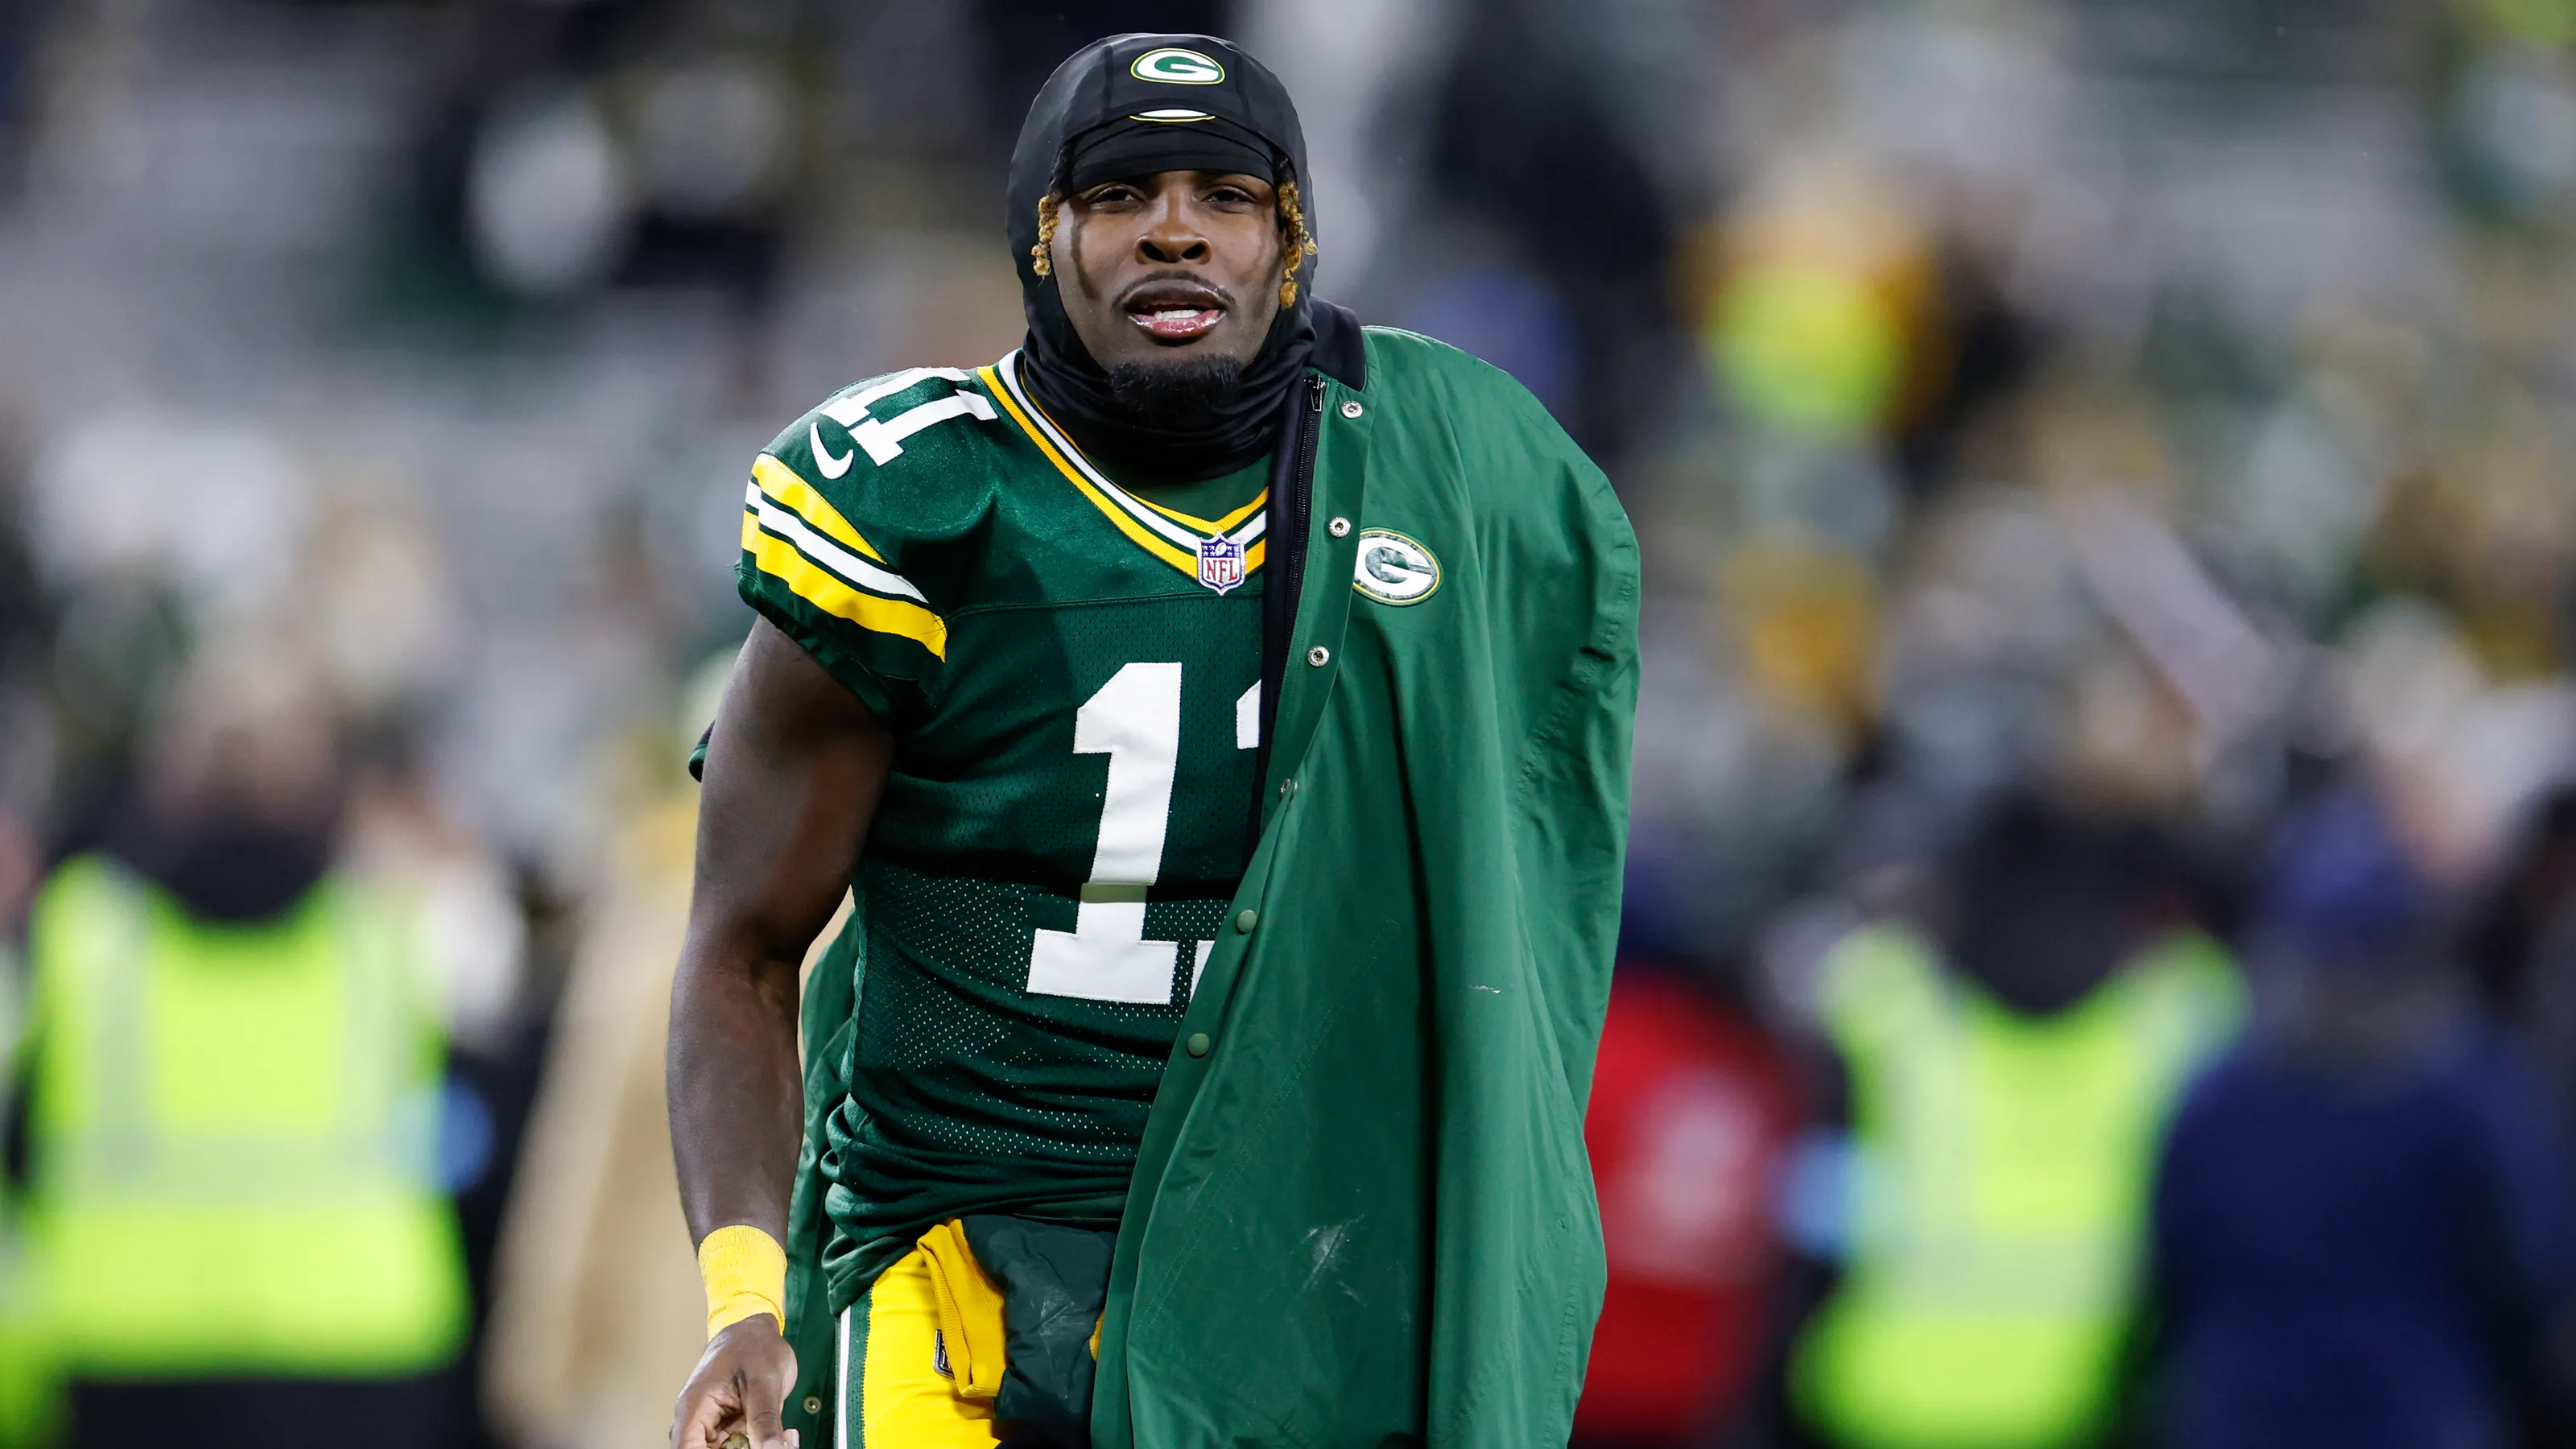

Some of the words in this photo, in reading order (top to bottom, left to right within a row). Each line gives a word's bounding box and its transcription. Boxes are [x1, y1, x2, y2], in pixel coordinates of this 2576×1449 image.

[1132, 48, 1224, 83] G
[819, 367, 998, 467] 11
[1206, 559, 1238, 584] NFL
[1353, 531, 1438, 599] G
[1026, 662, 1261, 1005] 1
